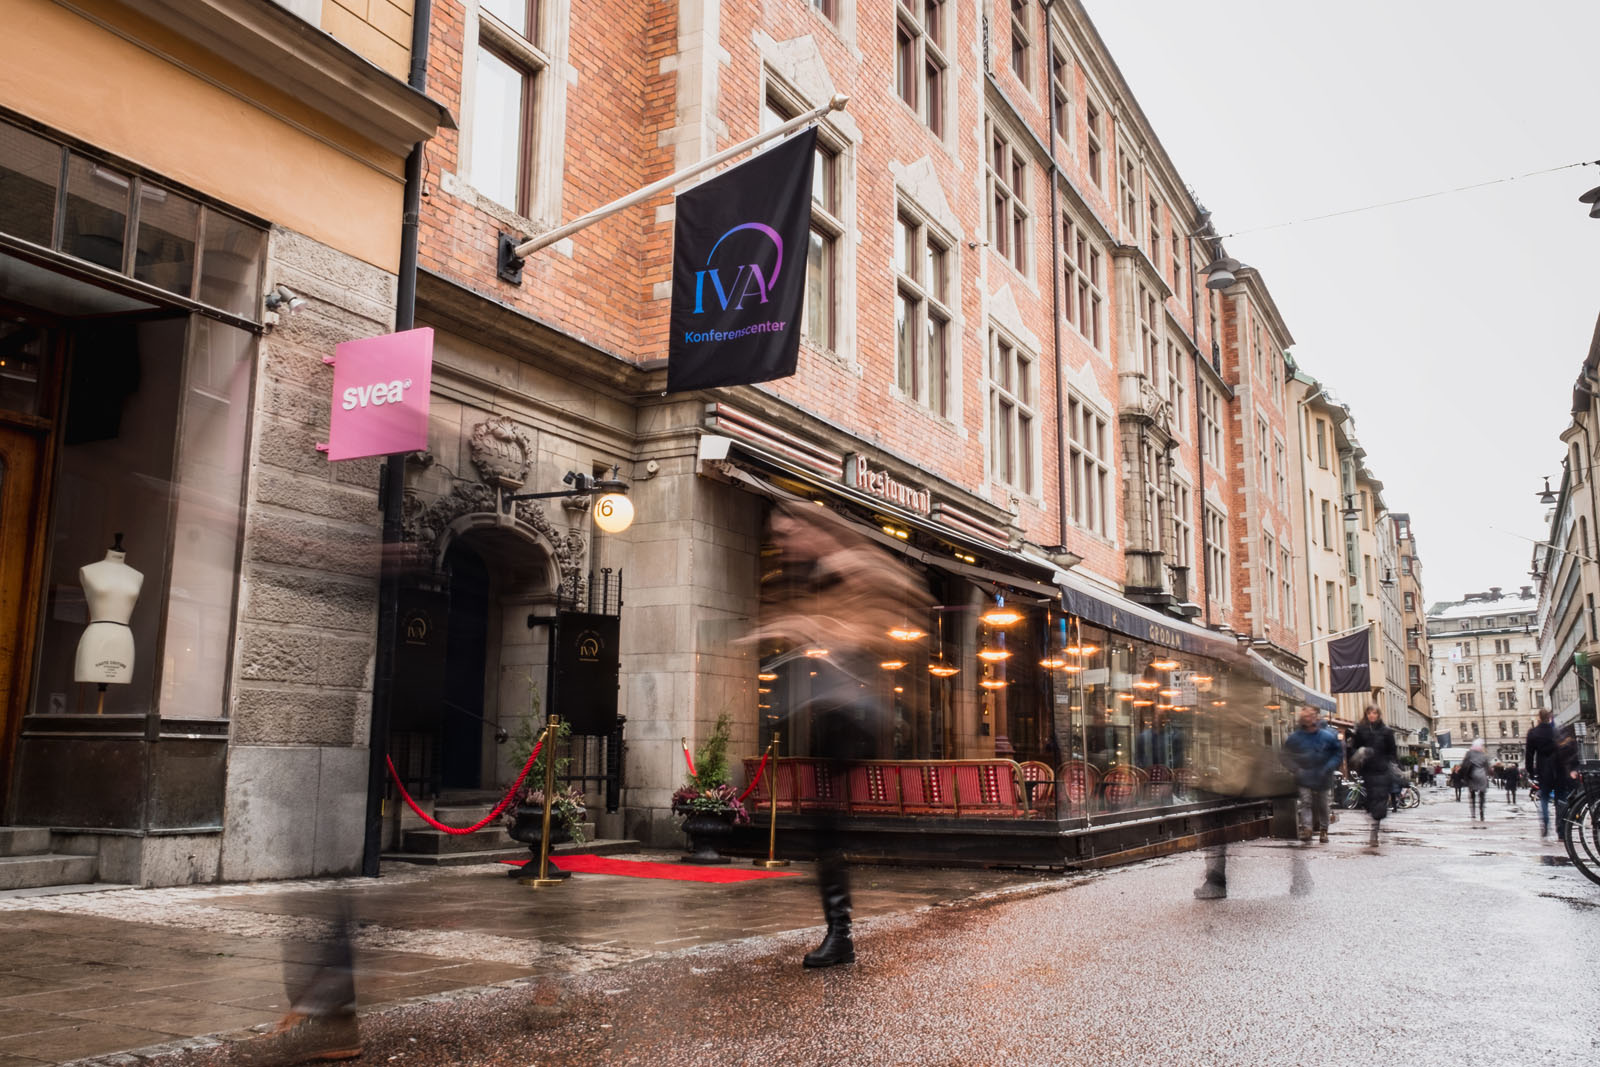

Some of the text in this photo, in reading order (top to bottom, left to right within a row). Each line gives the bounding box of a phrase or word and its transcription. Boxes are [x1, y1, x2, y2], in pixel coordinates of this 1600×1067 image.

[692, 263, 769, 314] IVA
[685, 320, 786, 344] Konferenscenter
[856, 452, 931, 515] Restaurant
[597, 499, 614, 517] 16
